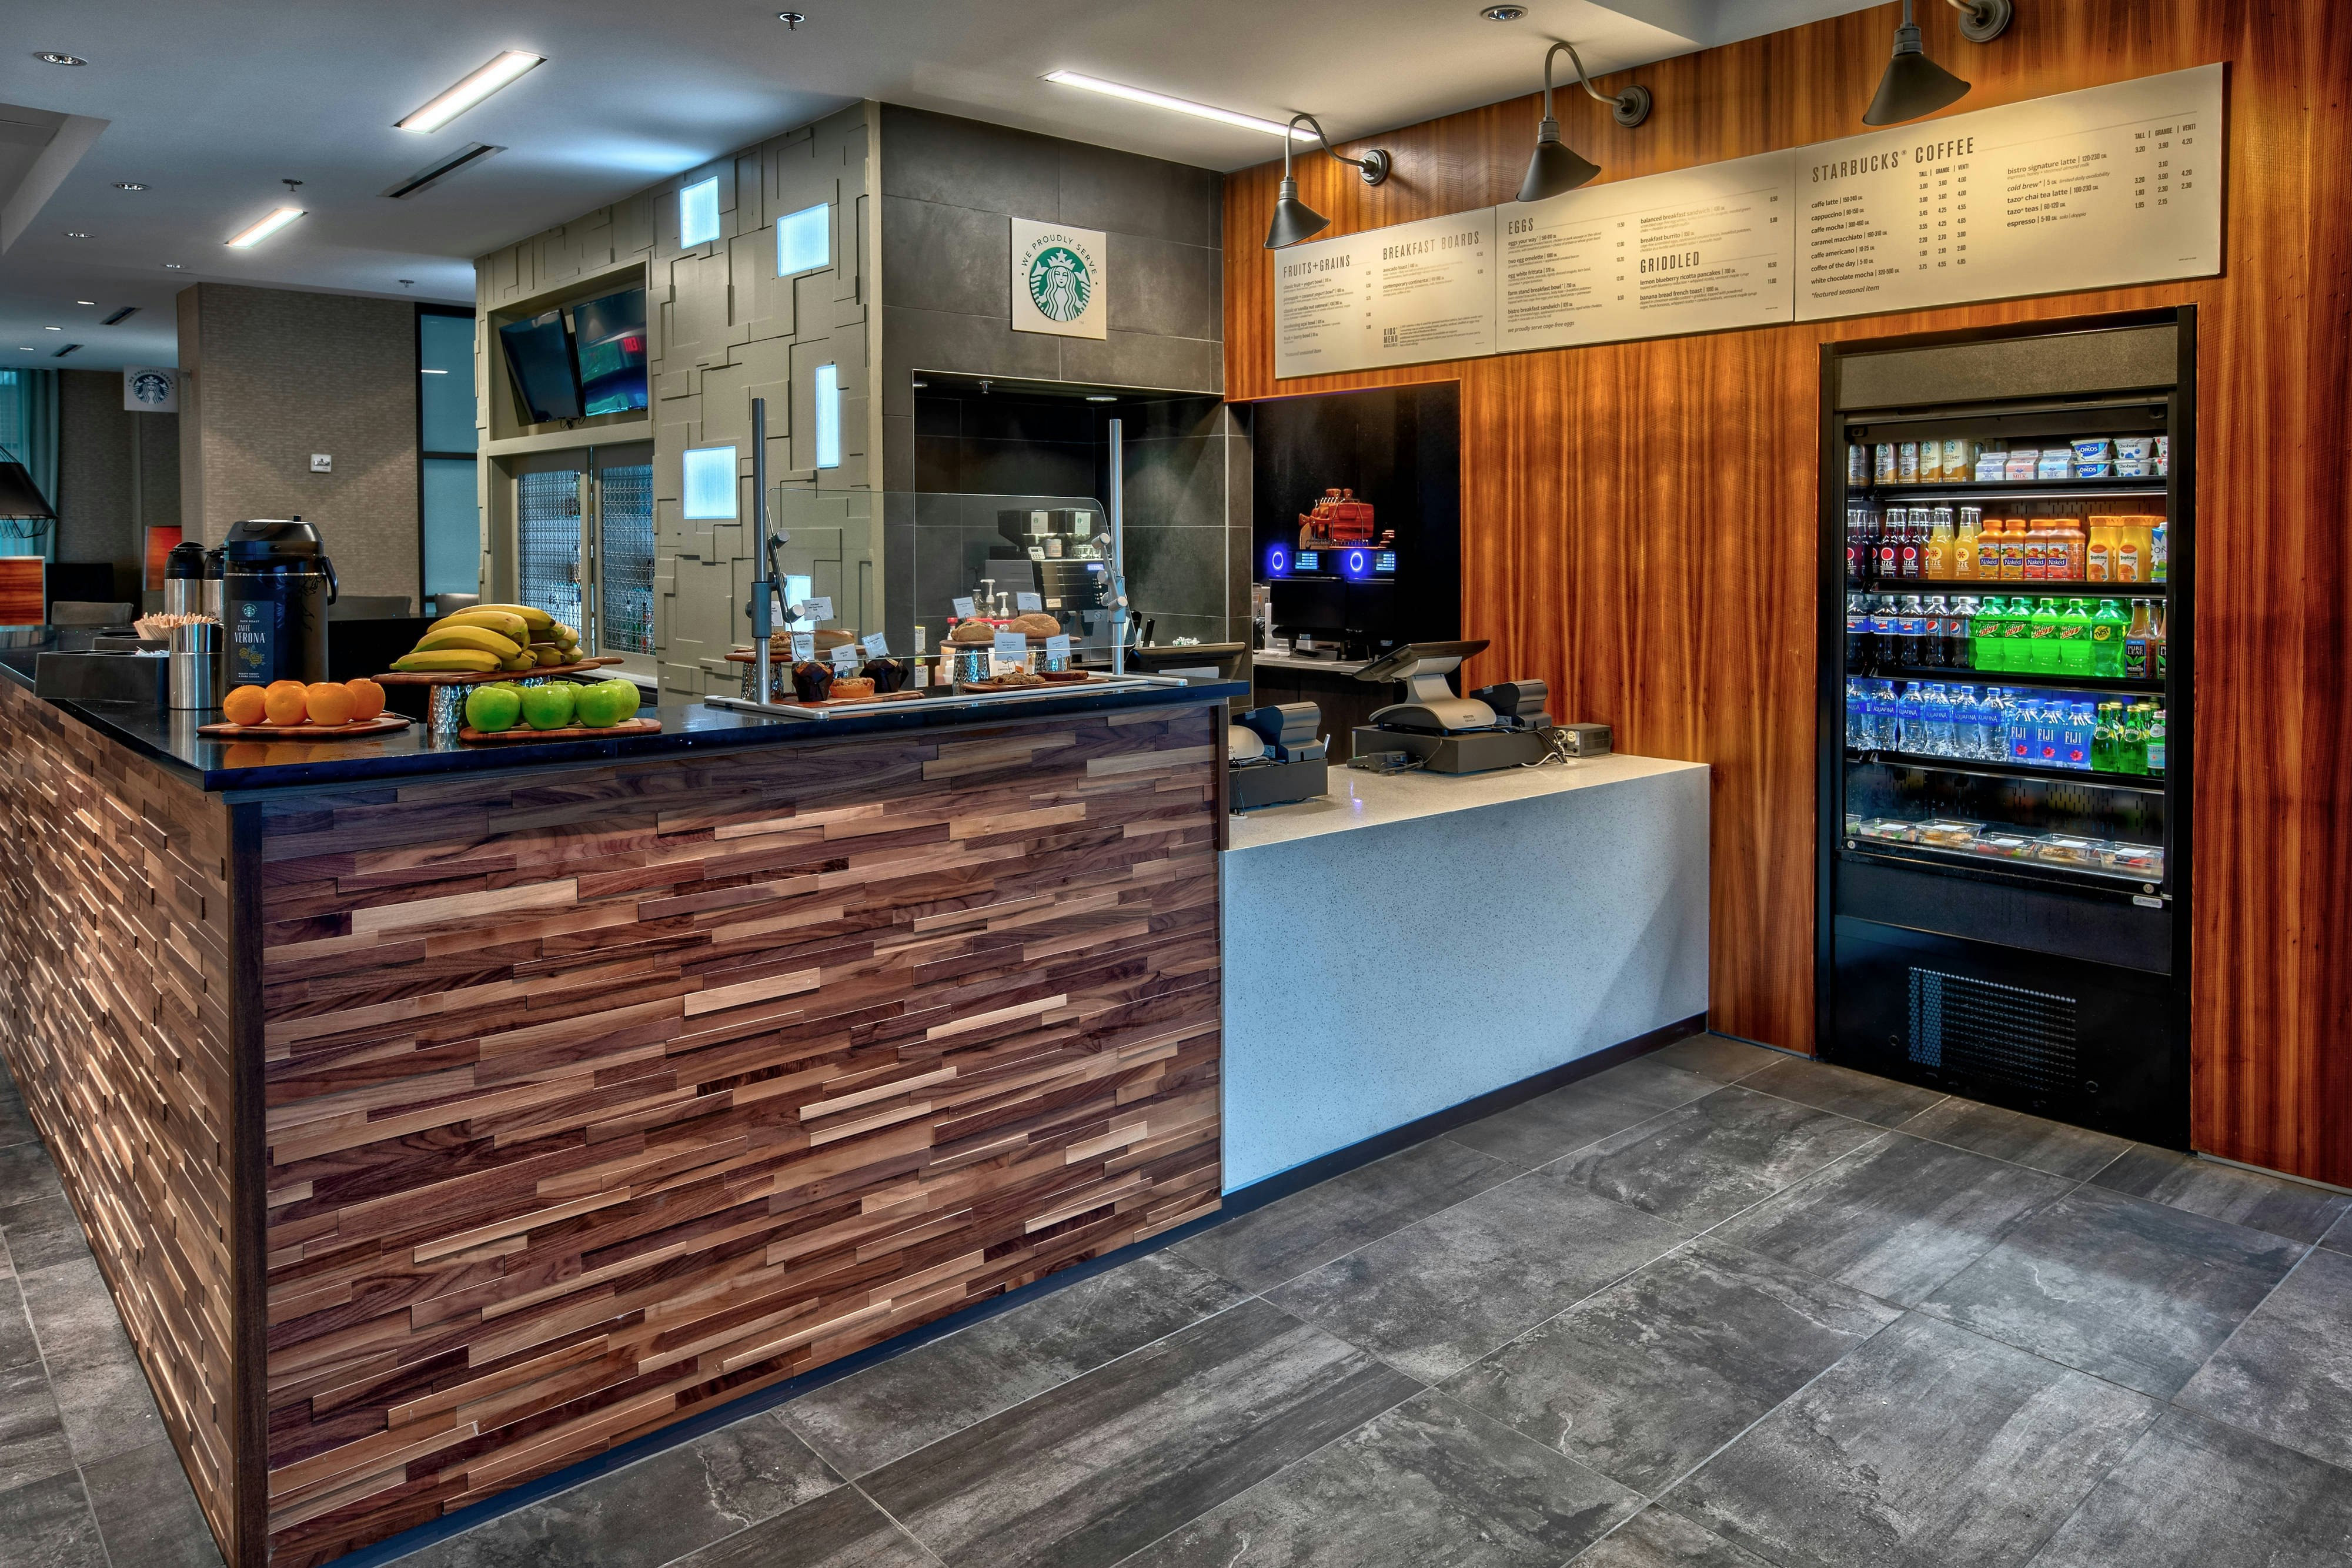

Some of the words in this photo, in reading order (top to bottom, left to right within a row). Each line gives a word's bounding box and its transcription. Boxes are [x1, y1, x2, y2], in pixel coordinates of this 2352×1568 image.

[2155, 128, 2173, 136] GRANDE
[1915, 137, 1973, 163] COFFEE
[2028, 161, 2059, 172] signature
[2060, 158, 2076, 166] latte
[2007, 183, 2022, 192] cold
[2025, 193, 2039, 201] chai
[2052, 189, 2068, 197] latte
[1641, 215, 1662, 224] balanced
[1663, 212, 1686, 220] breakfast
[1686, 207, 1710, 216] sandwich
[1811, 211, 1842, 222] cappuccino
[1508, 218, 1534, 235] EGGS
[1811, 226, 1825, 234] caffe
[1825, 223, 1844, 232] mocha
[2007, 218, 2036, 228] espresso
[1641, 235, 1663, 244] breakfast
[1811, 238, 1833, 247] caramel
[1834, 233, 1863, 243] macchiato
[1383, 239, 1435, 260] BREAKFAST
[1441, 231, 1479, 250] BOARDS
[1021, 251, 1033, 268] WE
[1032, 235, 1073, 250] PROUDLY
[1076, 244, 1097, 275] SERVE
[1825, 249, 1855, 257] americano
[1284, 255, 1350, 278] FRUITS+GRAINS
[1640, 251, 1699, 273] GRIDDLED
[1655, 274, 1679, 284] blueberry
[1697, 270, 1720, 279] pancakes
[1827, 274, 1853, 283] chocolate
[1383, 280, 1408, 289] contemporary
[1531, 285, 1550, 293] breakfast
[1673, 289, 1689, 297] french
[1839, 286, 1865, 295] seasonal
[1520, 305, 1540, 313] breakfast
[1514, 325, 1530, 333] proudly
[1384, 335, 1398, 343] MENU
[235, 632, 265, 643] VERONA
[2011, 726, 2026, 738] FIJI
[2038, 728, 2053, 741] FIJI
[2065, 731, 2081, 744] FIJI
